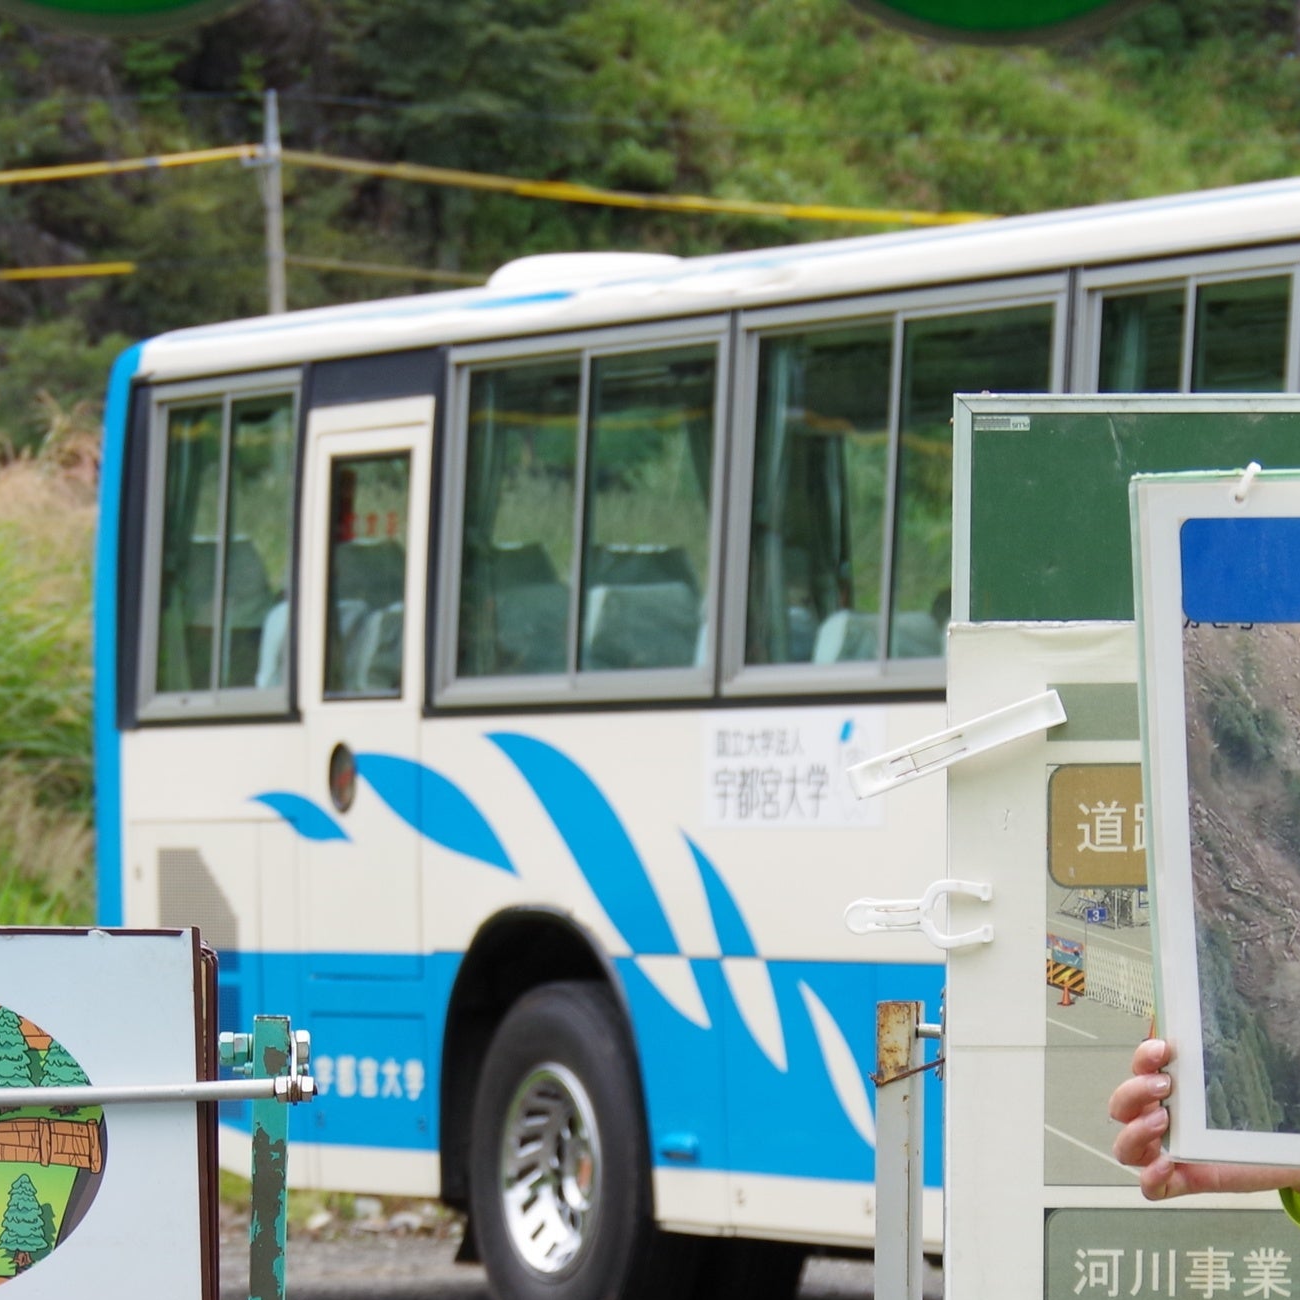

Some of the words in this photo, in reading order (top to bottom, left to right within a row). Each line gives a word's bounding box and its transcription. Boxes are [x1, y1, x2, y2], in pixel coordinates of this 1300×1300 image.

[714, 764, 831, 819] 宇都宮大学
[1073, 1246, 1293, 1300] 河川事業
